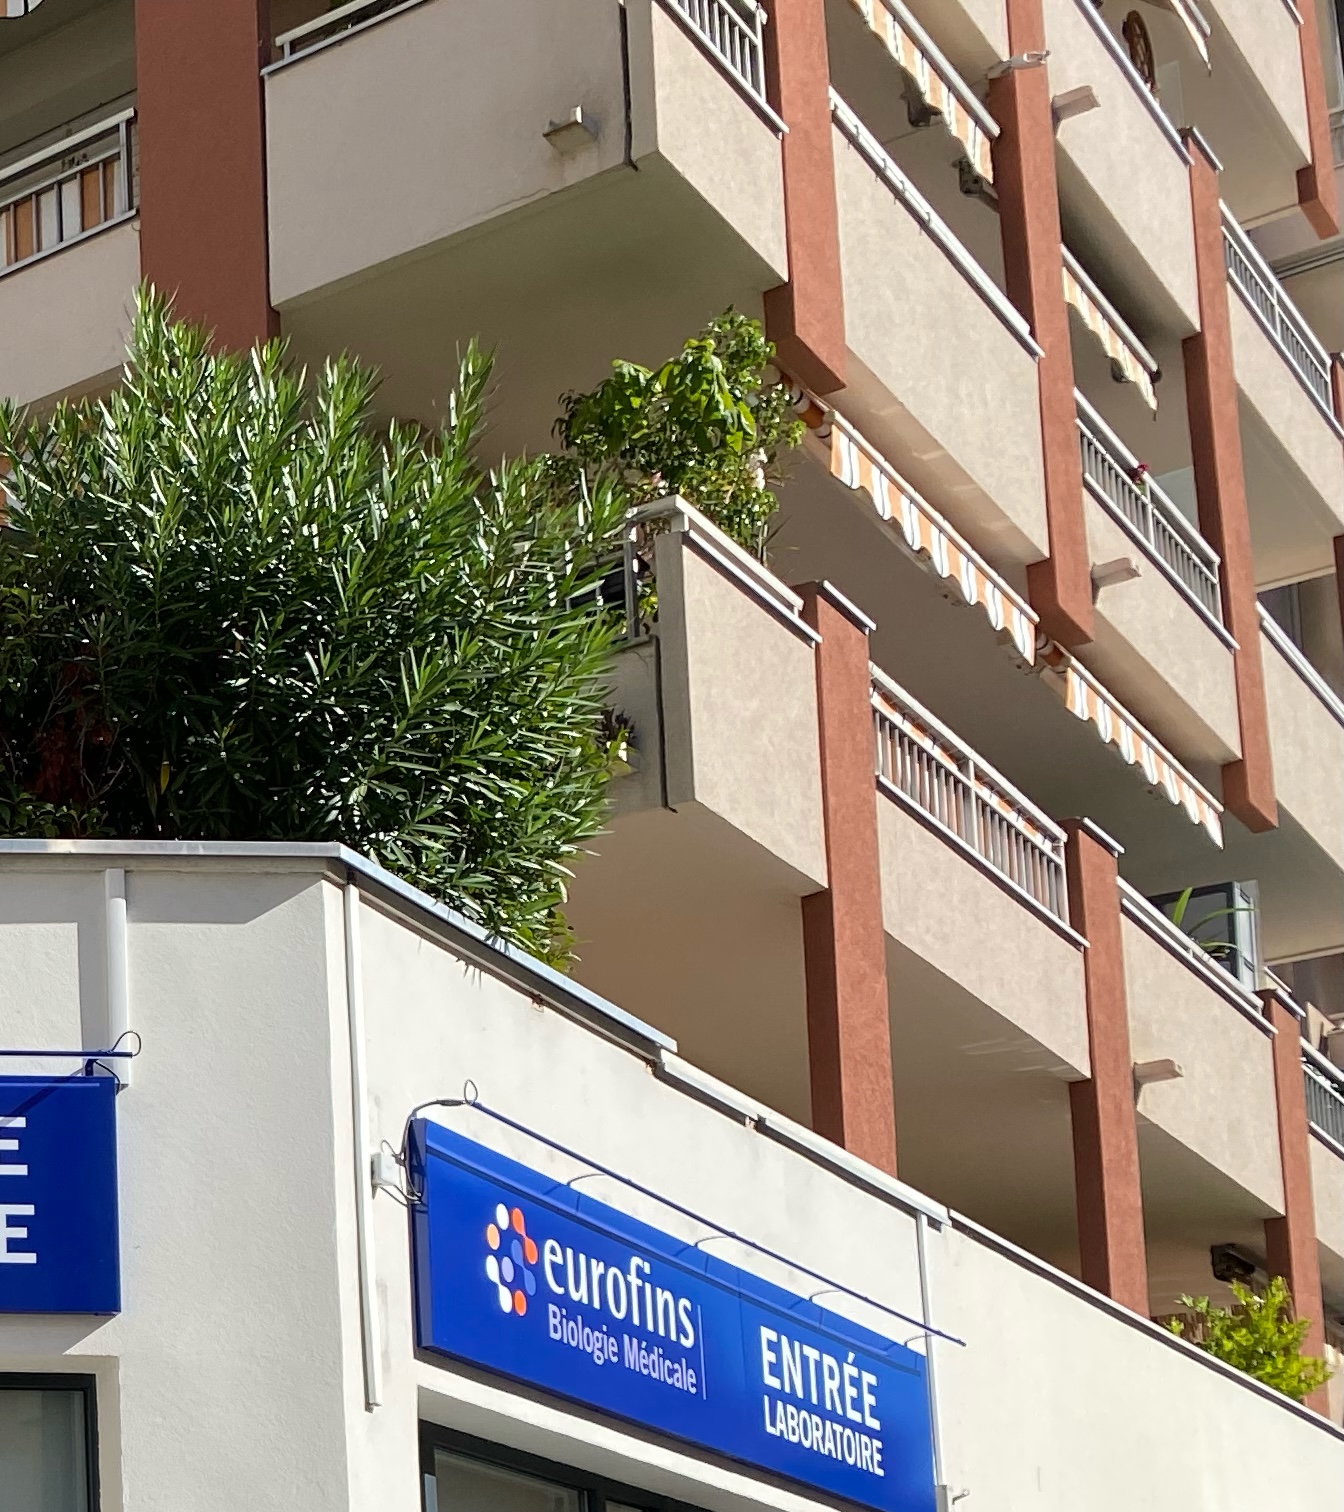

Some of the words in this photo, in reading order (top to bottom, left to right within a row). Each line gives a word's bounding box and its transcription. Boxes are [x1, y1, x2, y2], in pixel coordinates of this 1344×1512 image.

[543, 1238, 696, 1349] eurofins
[547, 1303, 619, 1366] Biologie
[623, 1333, 698, 1395] Médicale
[759, 1324, 882, 1431] ENTRÉE
[763, 1393, 885, 1477] LABORATOIRE
